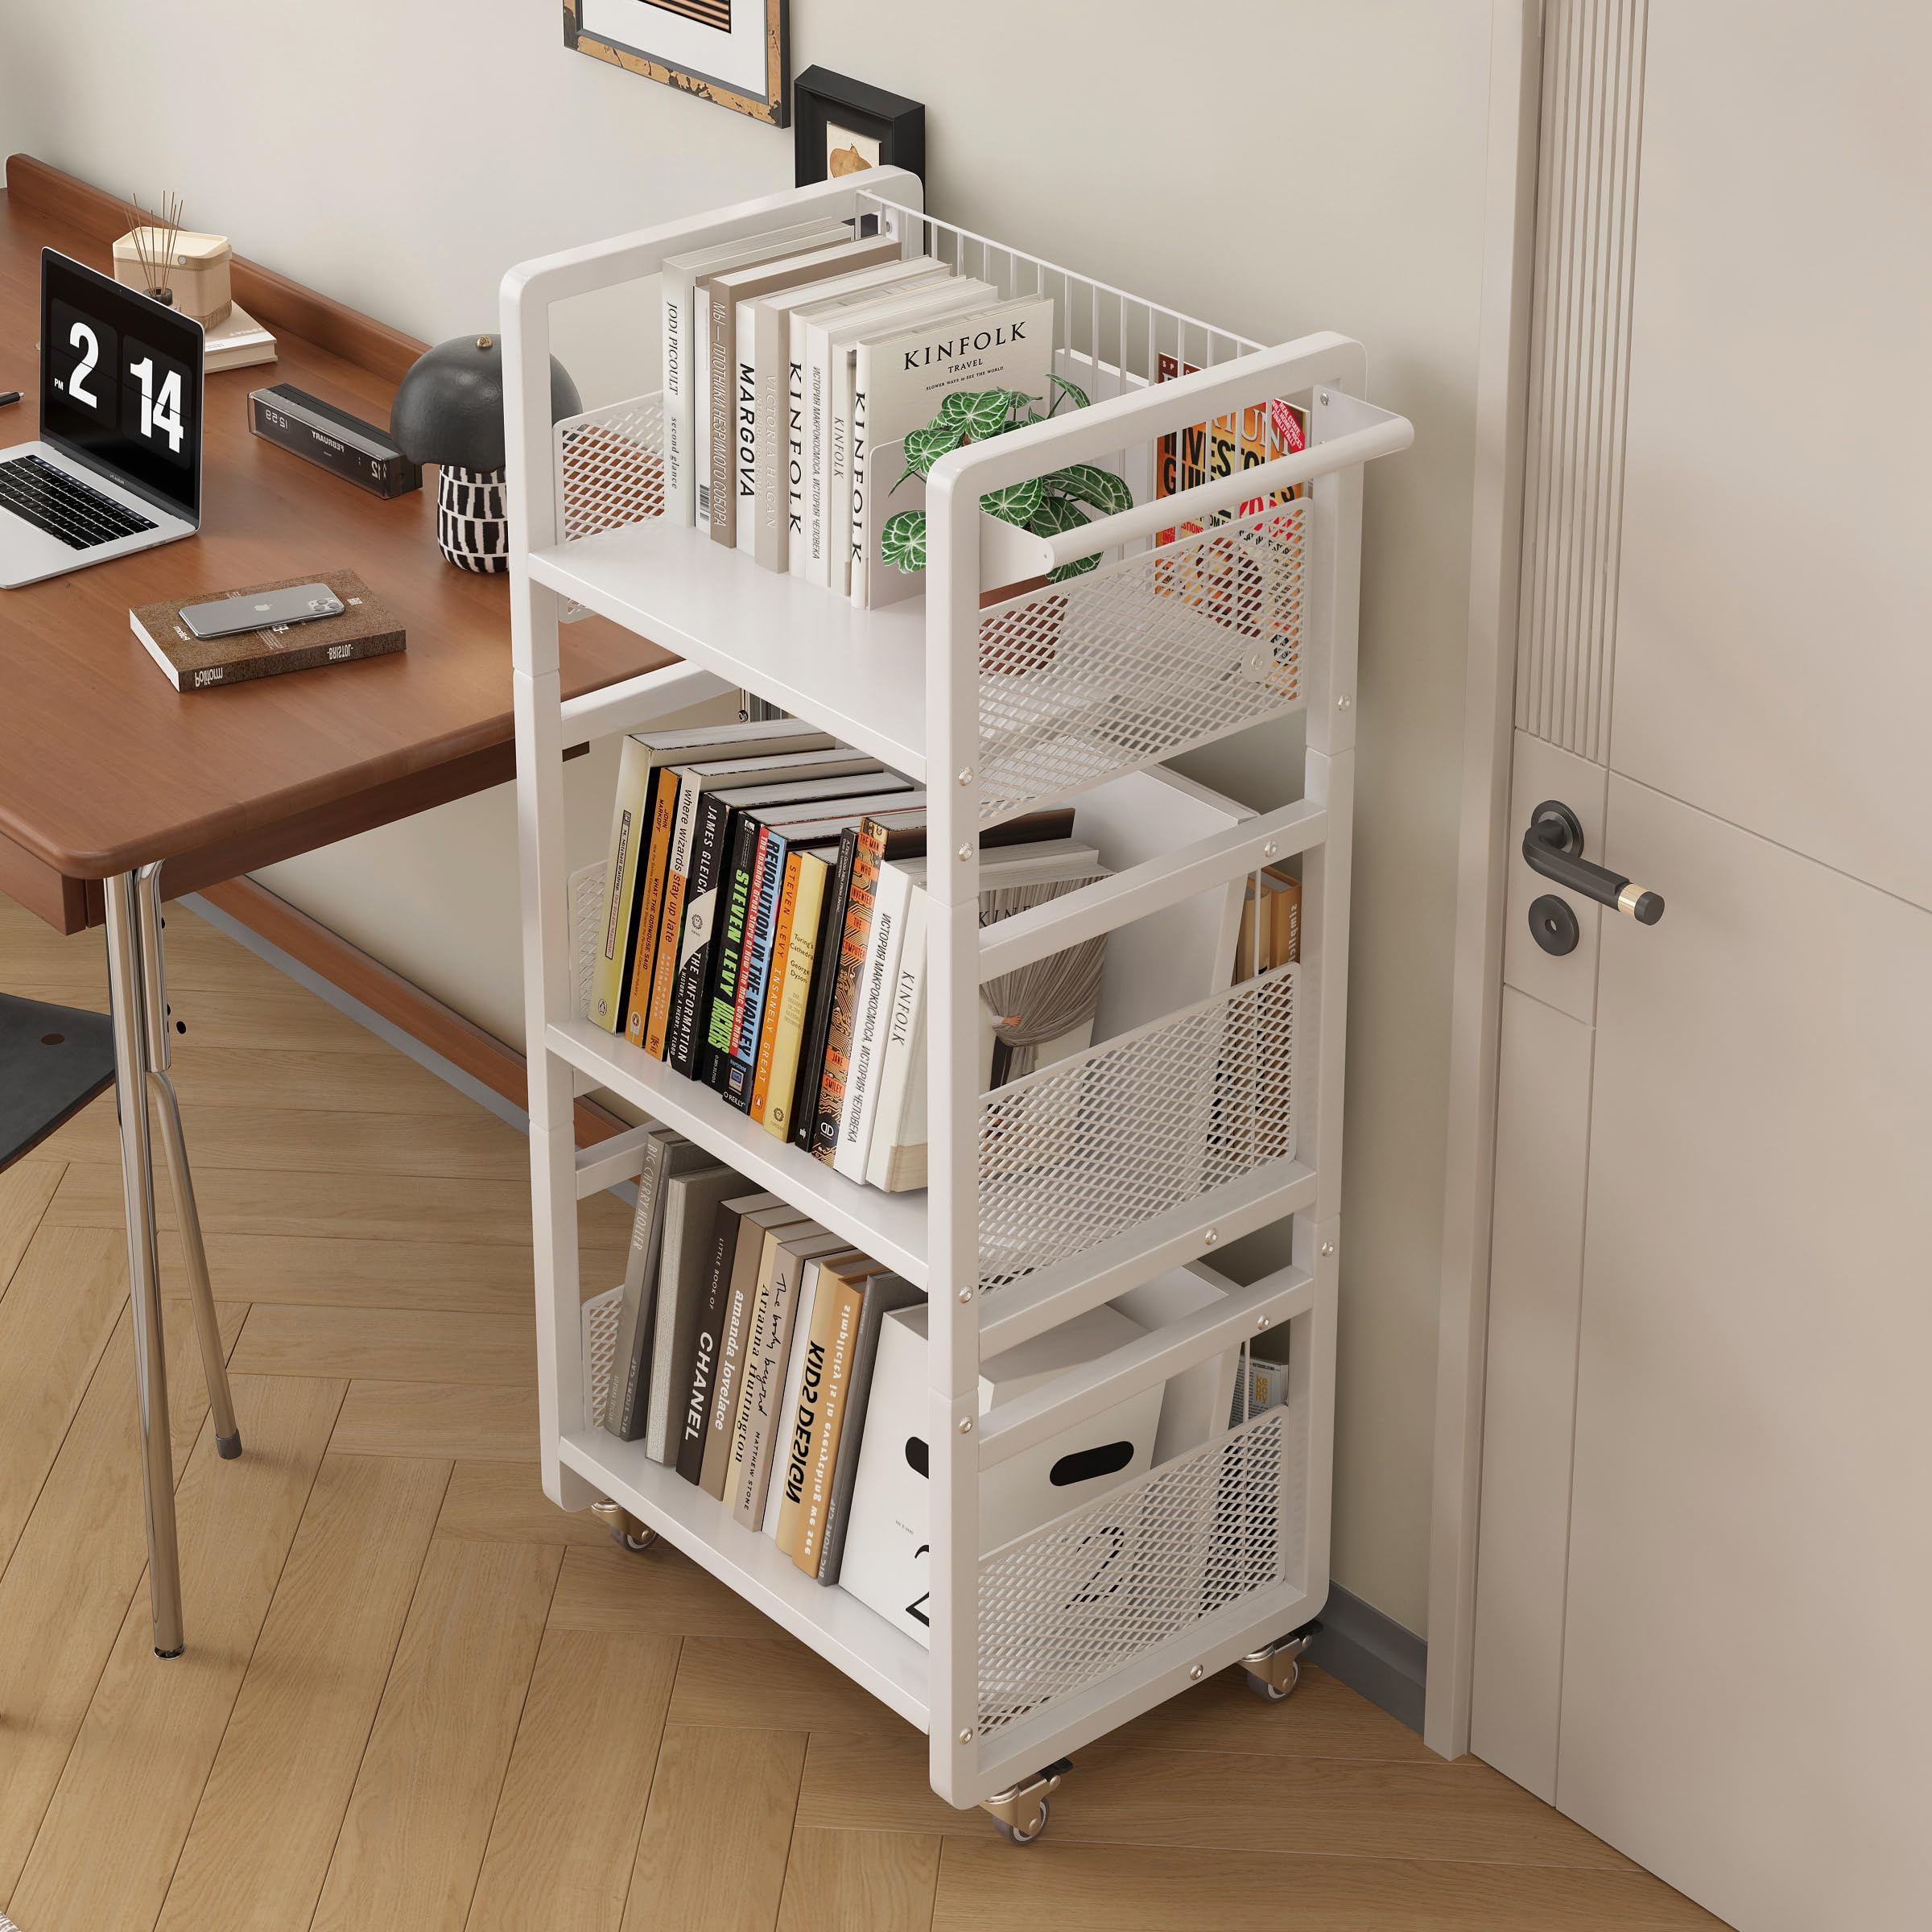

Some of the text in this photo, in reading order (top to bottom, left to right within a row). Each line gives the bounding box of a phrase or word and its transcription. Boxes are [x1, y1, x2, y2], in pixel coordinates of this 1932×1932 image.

[68, 322, 100, 410] 2
[667, 301, 679, 396] JODI PICOULT
[903, 321, 1026, 371] KINFOLK
[947, 358, 984, 374] TRAVEL
[54, 378, 64, 391] PM
[813, 366, 821, 407] ИСТОРИЯ
[926, 382, 945, 391] SLOWER
[987, 366, 1004, 374] WORLD
[130, 357, 184, 454] 14
[712, 301, 727, 526] МЫ ПЛОТНИКИ НЕЗРИМОГО СОБОРА
[1272, 410, 1286, 432] FINALLY
[1279, 402, 1289, 419] REAL
[740, 362, 755, 496] MARGOVA
[789, 361, 802, 535] KINFOLK
[834, 417, 844, 479] KINFOLK
[1280, 411, 1292, 431] HOME
[1290, 427, 1303, 449] PRICES
[670, 417, 679, 489] second glance
[766, 375, 776, 528] VICTORIA HAGAN
[812, 477, 820, 517] ИСТОРИЯ
[852, 392, 865, 564] KINFOLK
[812, 518, 820, 559] ЧЕЛОВЕКА
[656, 799, 664, 832] MARKOFF
[696, 805, 718, 894] JAMES GLEICK
[760, 836, 768, 851] The
[860, 833, 879, 852] THE MAN
[665, 790, 692, 943] where wizards stay up late
[754, 852, 765, 890] Insanely
[860, 863, 872, 877] WHO
[727, 869, 749, 944] STEVEN
[777, 865, 797, 958] STEVEN LEVY
[852, 886, 873, 906] INVENTED
[645, 914, 655, 953] DORMOUSE
[748, 914, 757, 940] Story
[794, 933, 814, 949] Turing's
[853, 917, 863, 929] THE
[876, 913, 891, 961] ИСТОРИЯ
[689, 952, 702, 975] THE
[737, 838, 780, 1057] REVOLUTION IN THE VALLEY
[743, 950, 752, 968] How
[790, 960, 810, 976] George
[842, 939, 865, 960] COMPUTER
[720, 949, 738, 998] LEVY
[790, 969, 808, 984] Dyson
[677, 976, 698, 1063] INFORMATION
[708, 997, 735, 1054] HACKERS
[758, 967, 782, 1083] INSANELY GREAT
[891, 970, 915, 1046] KINFOLK
[670, 1035, 678, 1055] FLOOD
[831, 1053, 844, 1067] JANE
[825, 1078, 843, 1096] SMILEY
[855, 1043, 871, 1093] ИСТОРИЯ
[847, 1094, 863, 1143] ЧЕЛОВЕКА
[633, 1143, 658, 1250] BIG CHERRY HOLLER
[708, 1237, 725, 1311] LITTLE BOOK OF
[774, 1273, 786, 1307] The
[715, 1290, 744, 1430] amanda lovelace
[684, 1331, 714, 1441] CHANEL
[744, 1431, 761, 1511] MATTHEW STONE
[822, 1517, 832, 1555] STONE
[819, 1558, 827, 1578] BIG
